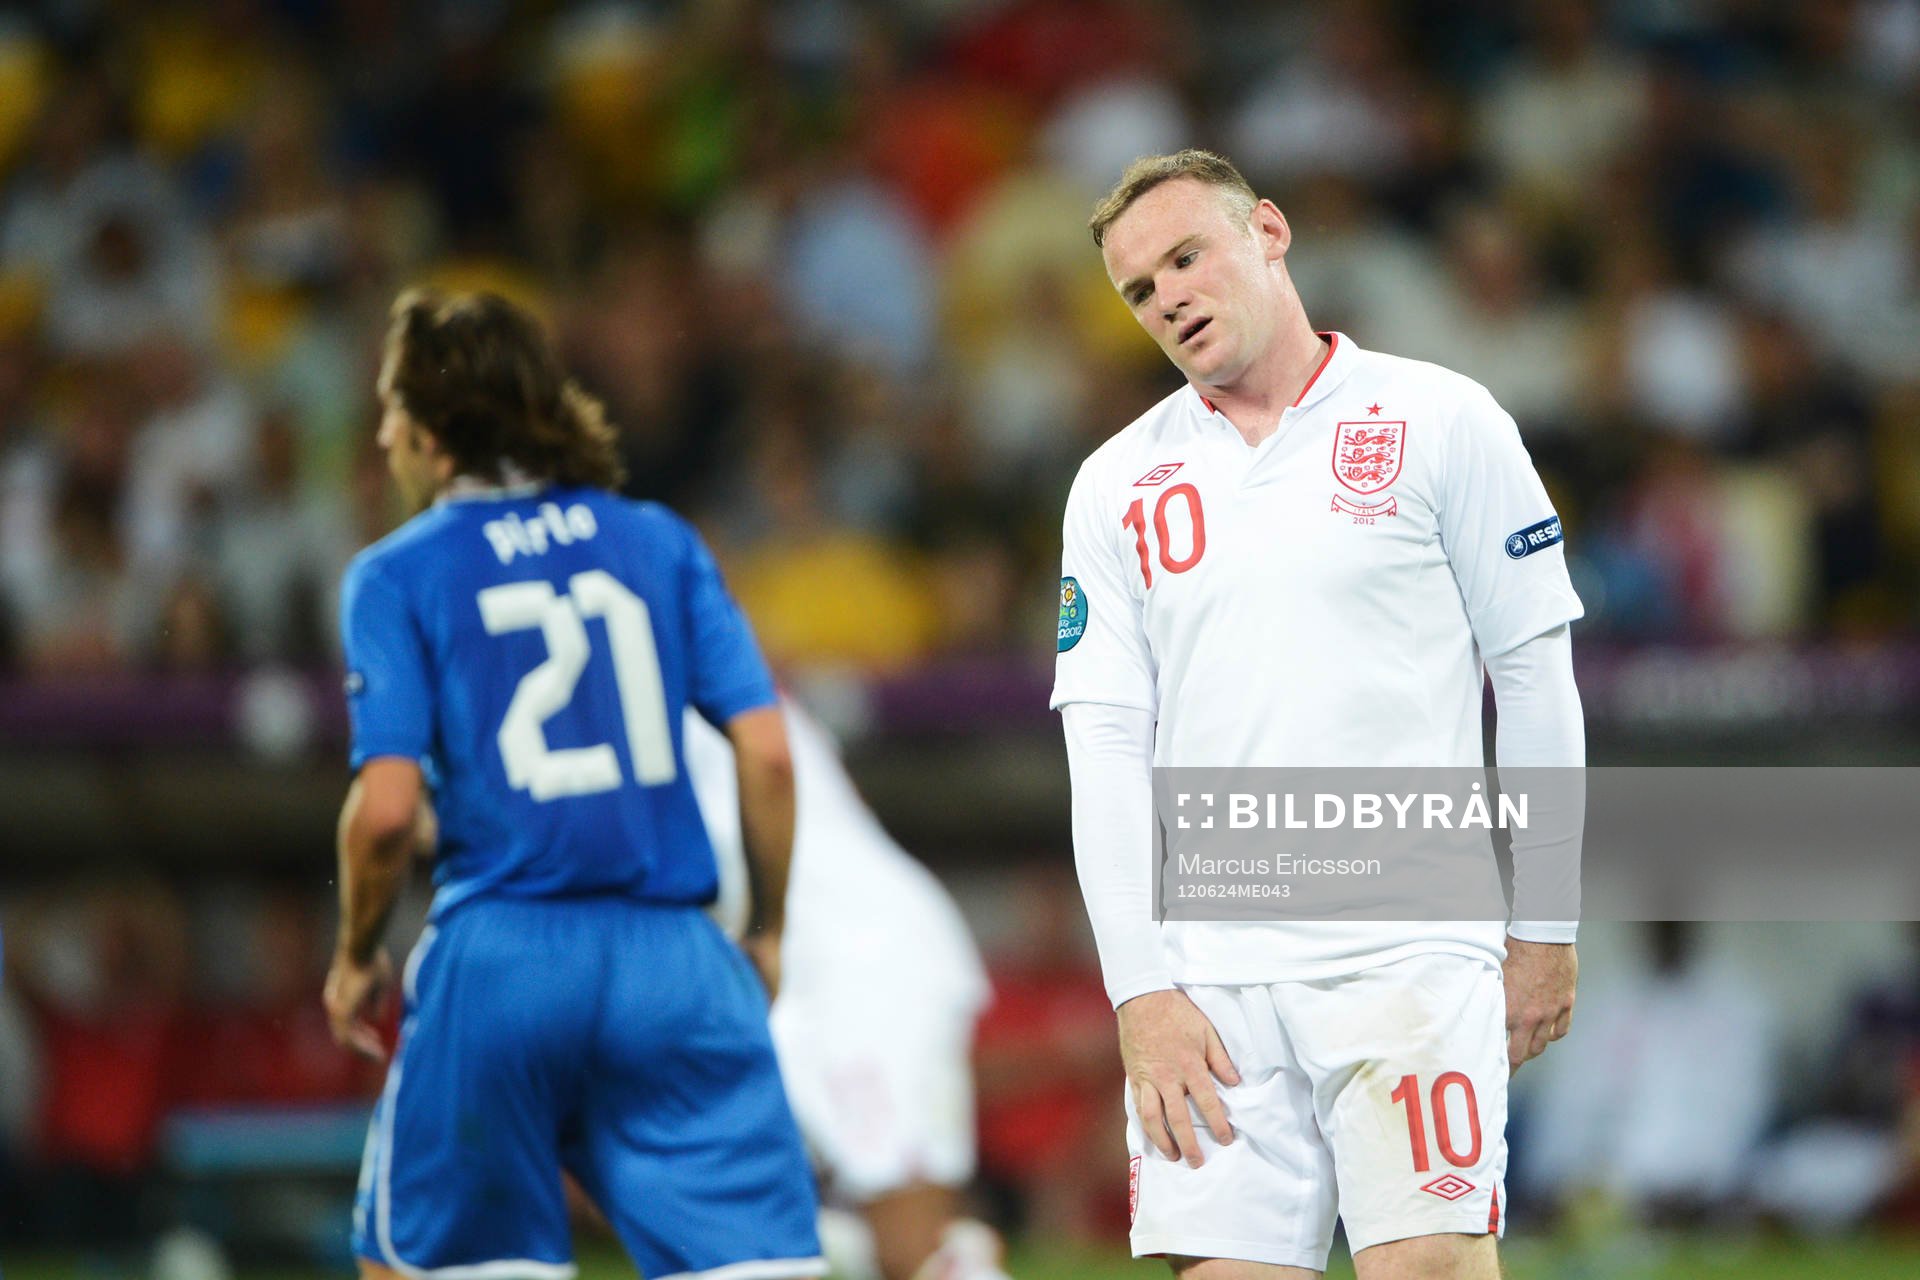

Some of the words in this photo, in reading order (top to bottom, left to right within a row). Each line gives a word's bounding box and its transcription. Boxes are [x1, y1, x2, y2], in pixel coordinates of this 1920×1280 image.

[1122, 483, 1206, 590] 10
[1353, 517, 1375, 525] 2012
[477, 569, 677, 802] 21
[1391, 1071, 1482, 1172] 10
